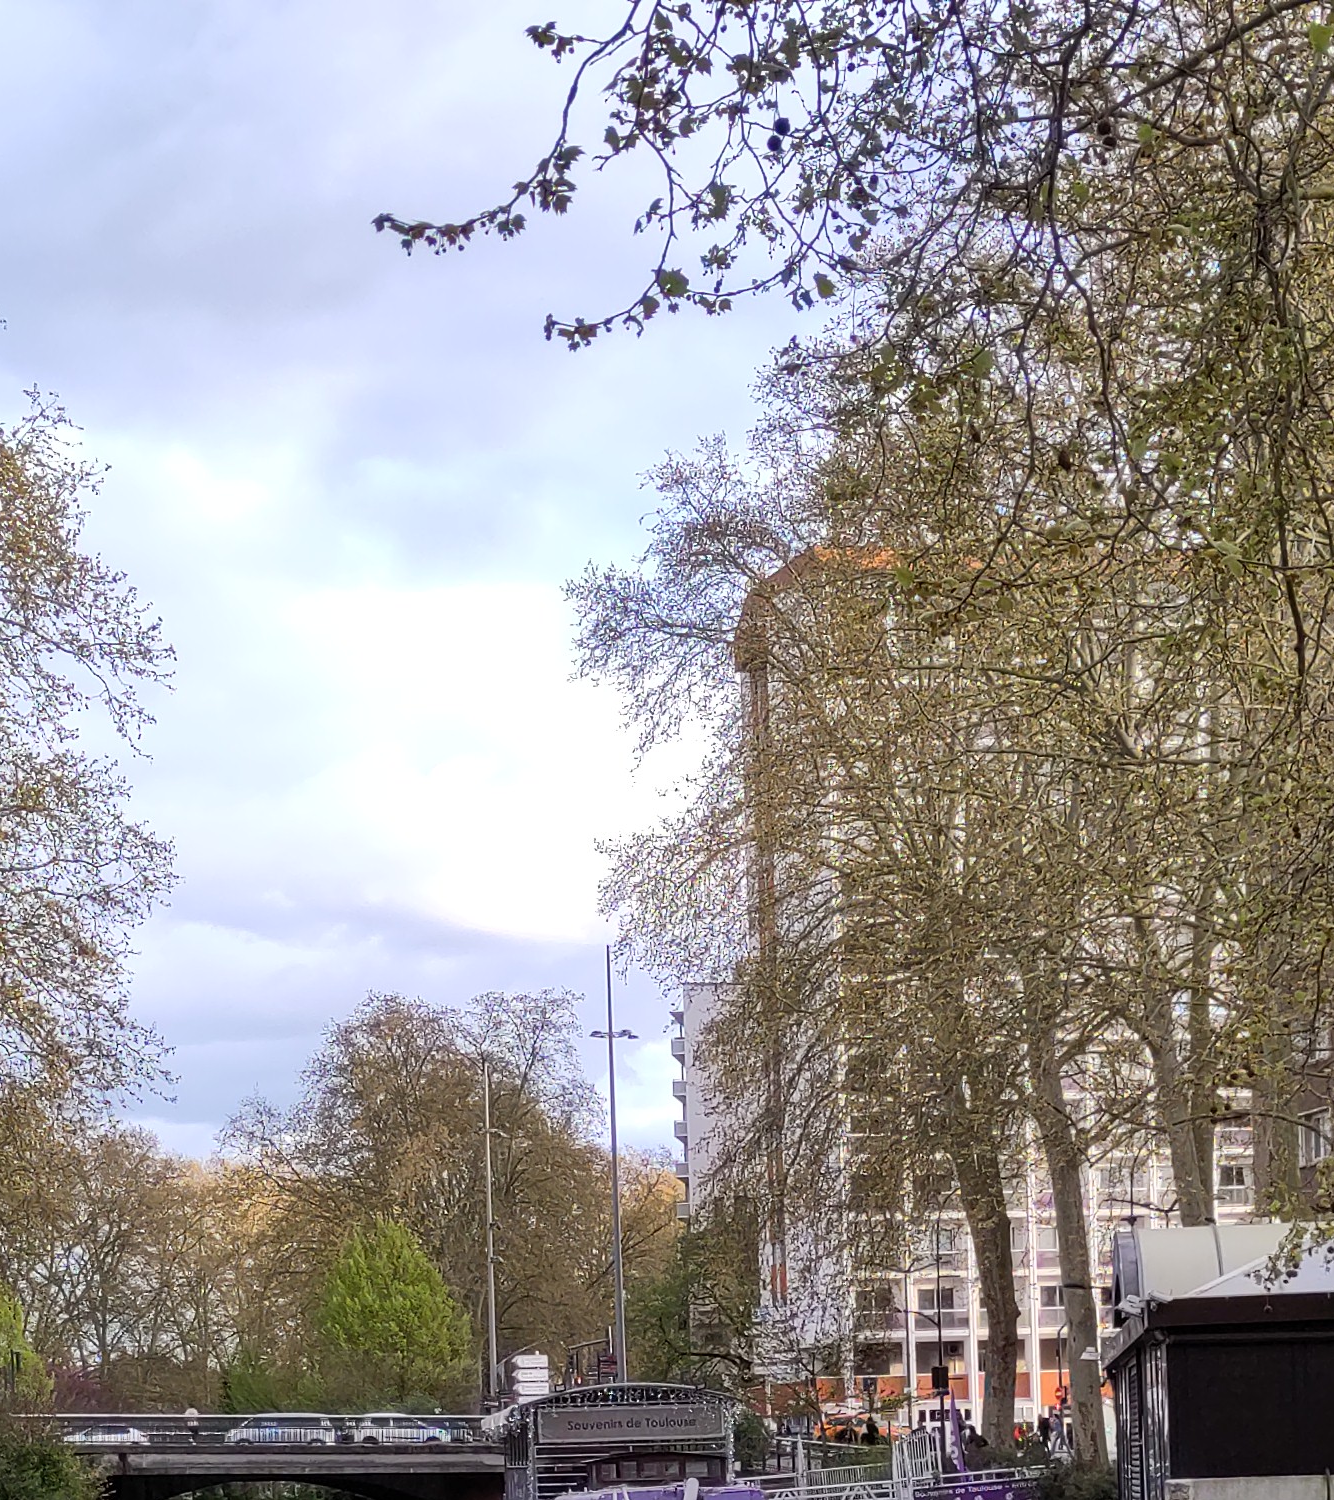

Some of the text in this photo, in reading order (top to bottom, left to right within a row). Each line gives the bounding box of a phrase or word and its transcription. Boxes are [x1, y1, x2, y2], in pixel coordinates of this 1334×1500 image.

[567, 1416, 696, 1431] Souvenirs de Toulouse
